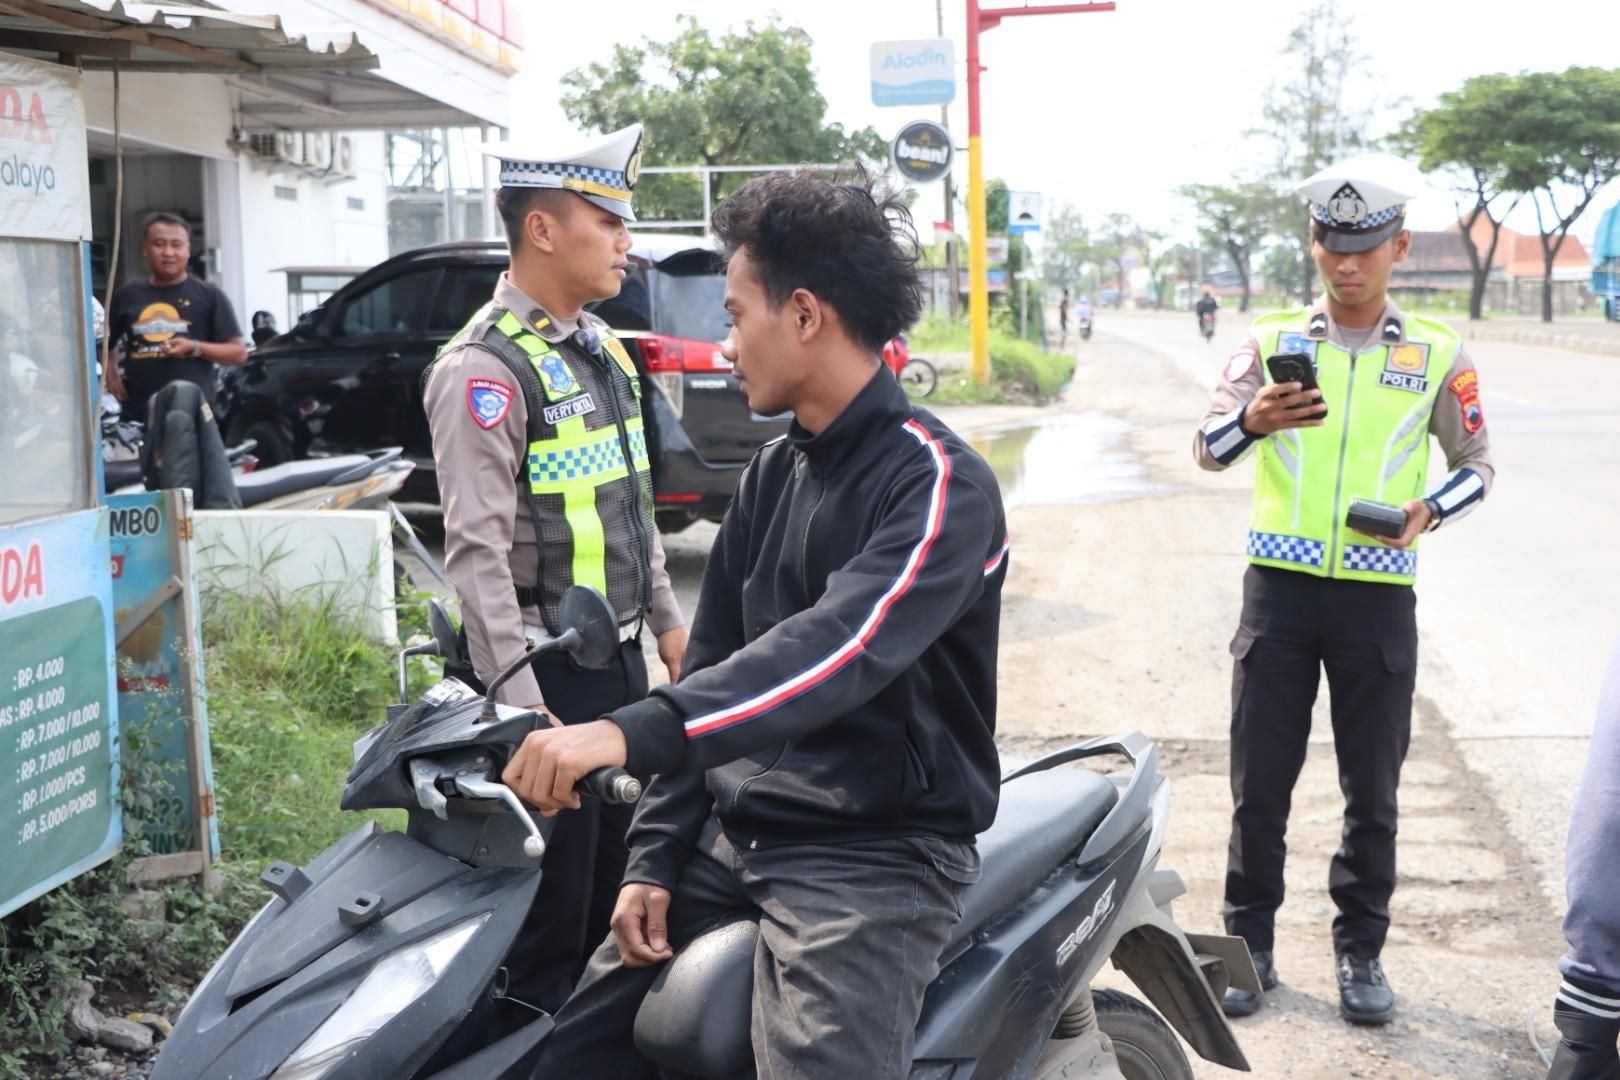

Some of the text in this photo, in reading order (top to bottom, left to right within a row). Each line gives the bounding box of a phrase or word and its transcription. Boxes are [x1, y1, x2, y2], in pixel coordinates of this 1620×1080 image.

[880, 47, 946, 70] Aladin
[1381, 374, 1425, 392] POLRI
[546, 402, 572, 421] VERY
[109, 506, 161, 537] MBO
[2, 543, 43, 604] DA
[35, 656, 64, 682] 4.000
[36, 686, 65, 712] 4.000
